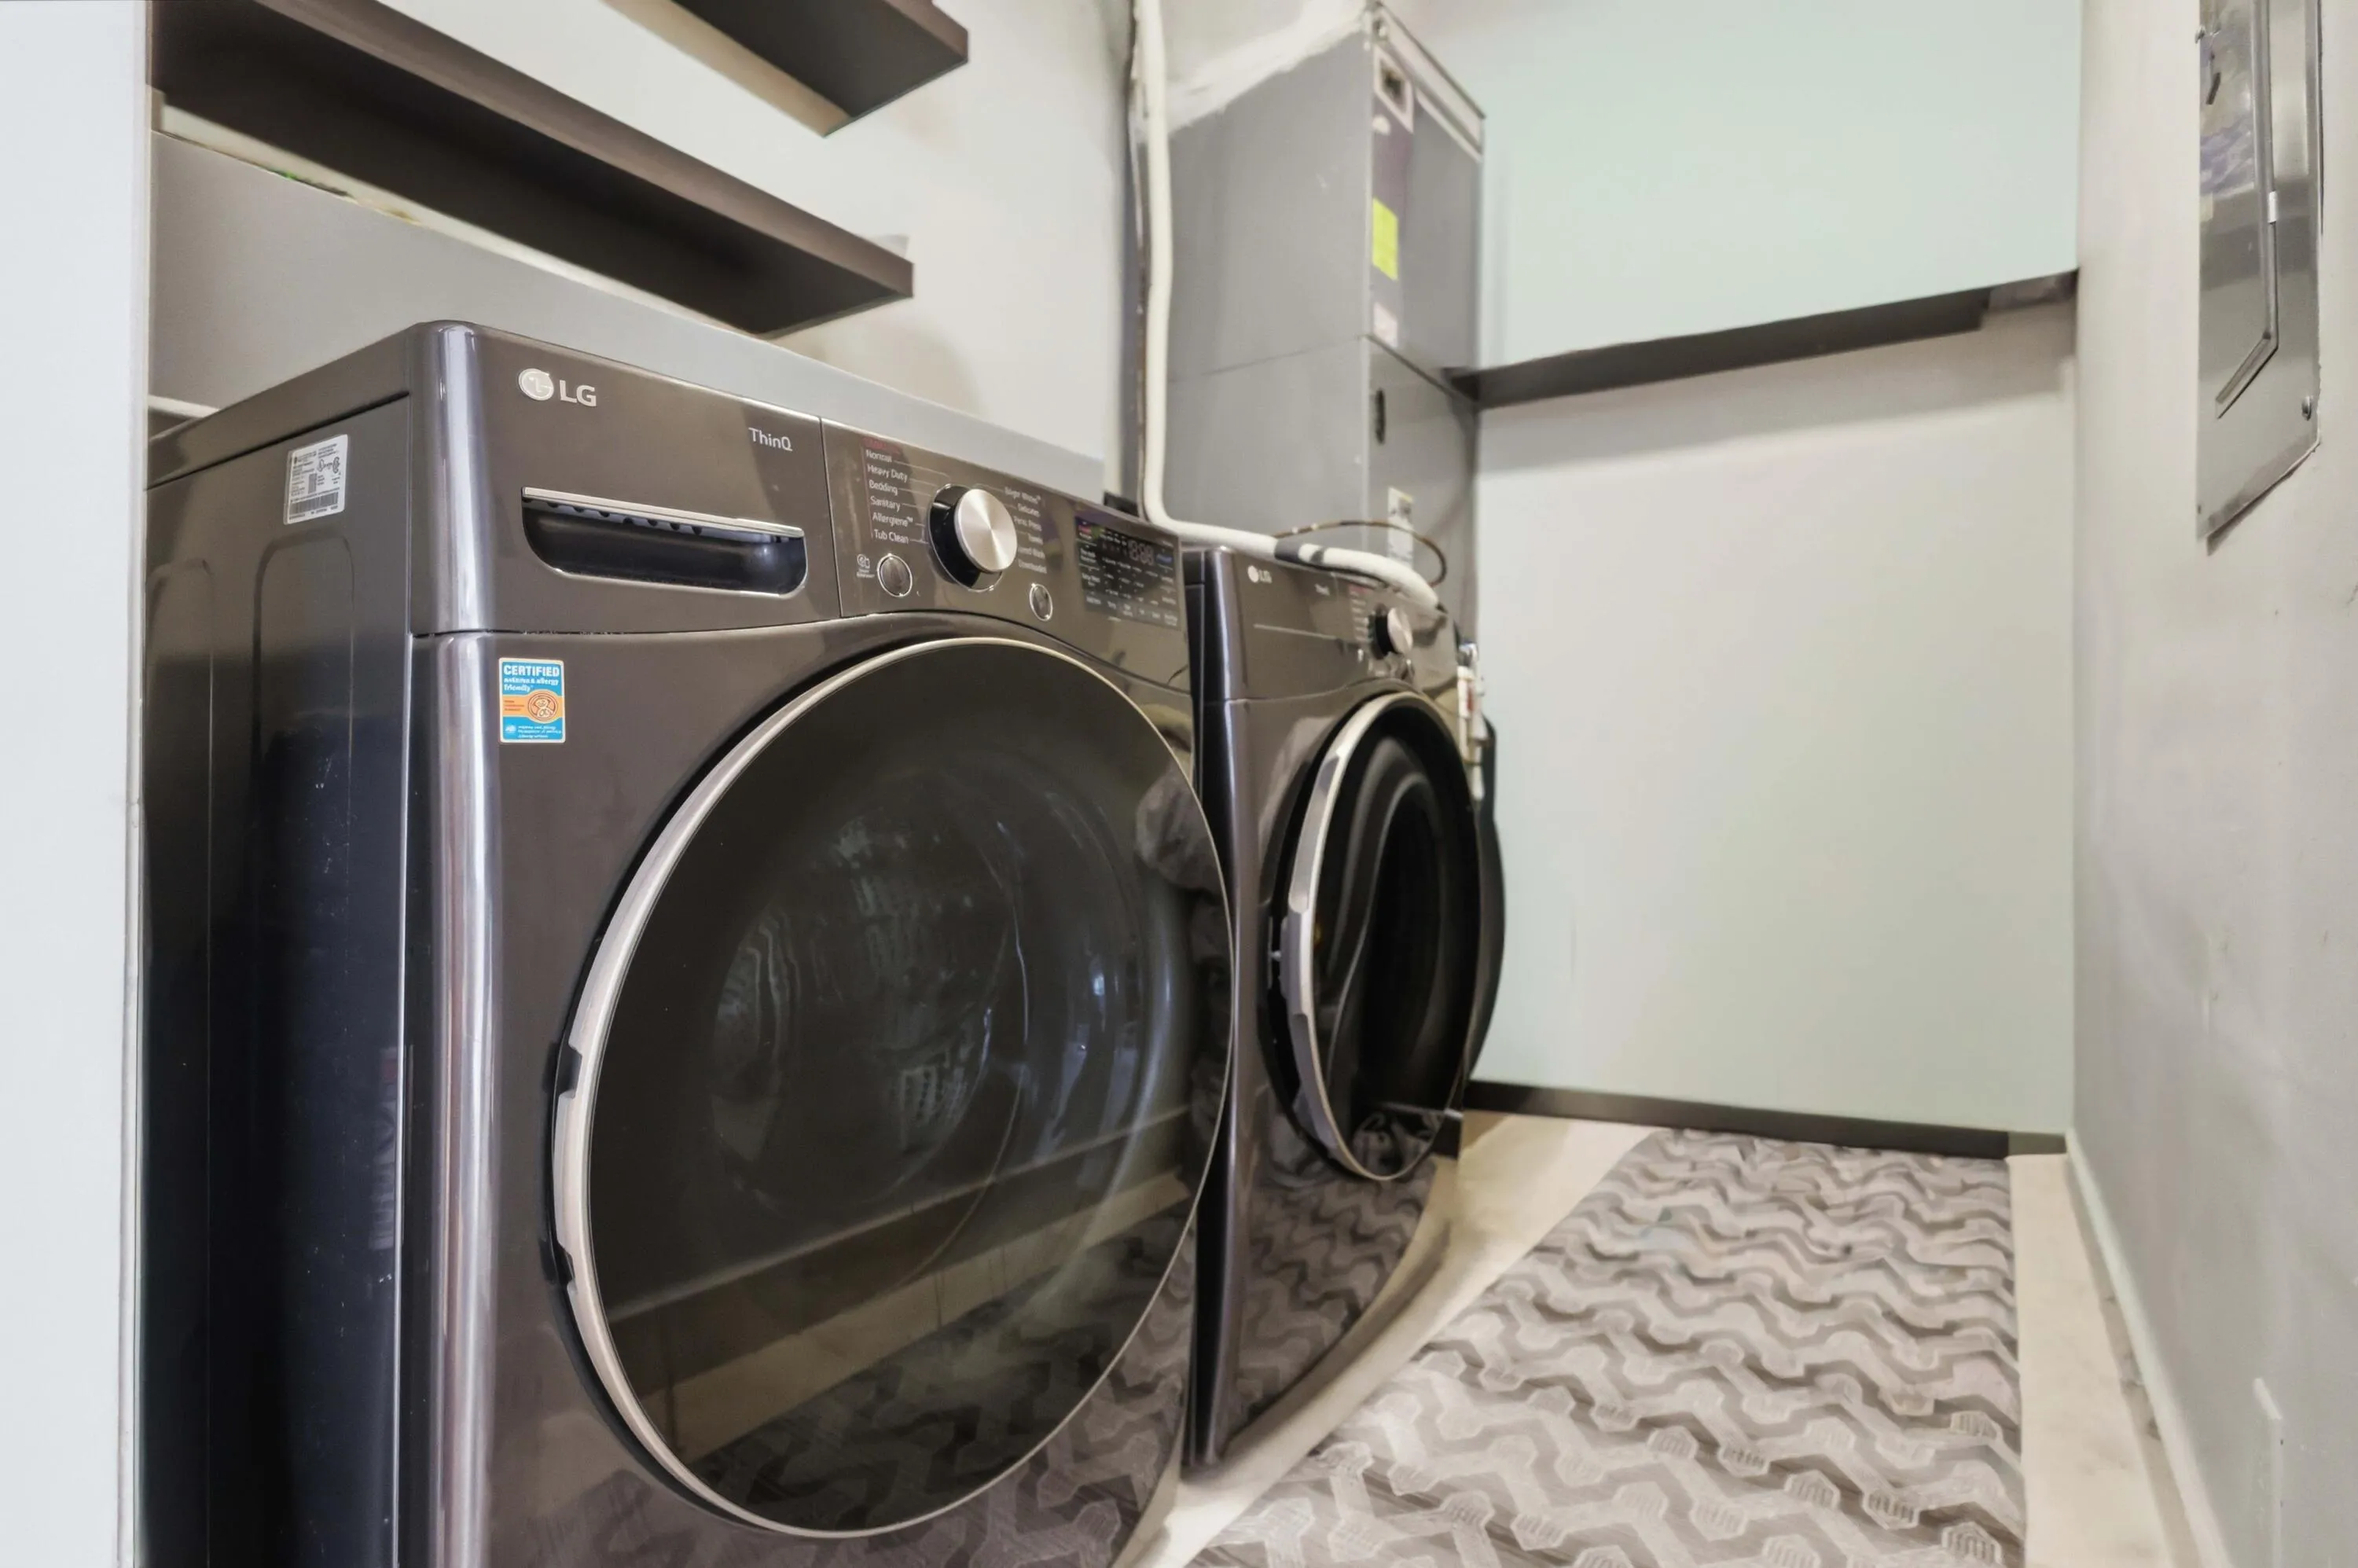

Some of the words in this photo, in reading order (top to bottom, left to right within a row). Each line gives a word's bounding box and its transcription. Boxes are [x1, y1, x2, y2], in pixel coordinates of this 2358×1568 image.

[559, 380, 597, 407] LG
[748, 427, 793, 452] ThinQ
[865, 449, 892, 463] Normal
[866, 465, 890, 478] Heavy
[891, 468, 908, 483] Duty
[869, 479, 898, 496] Bedding
[870, 496, 901, 512] Sanitary
[873, 528, 887, 540] Tub
[888, 531, 909, 545] Clean
[503, 665, 560, 677] CERTIFIED
